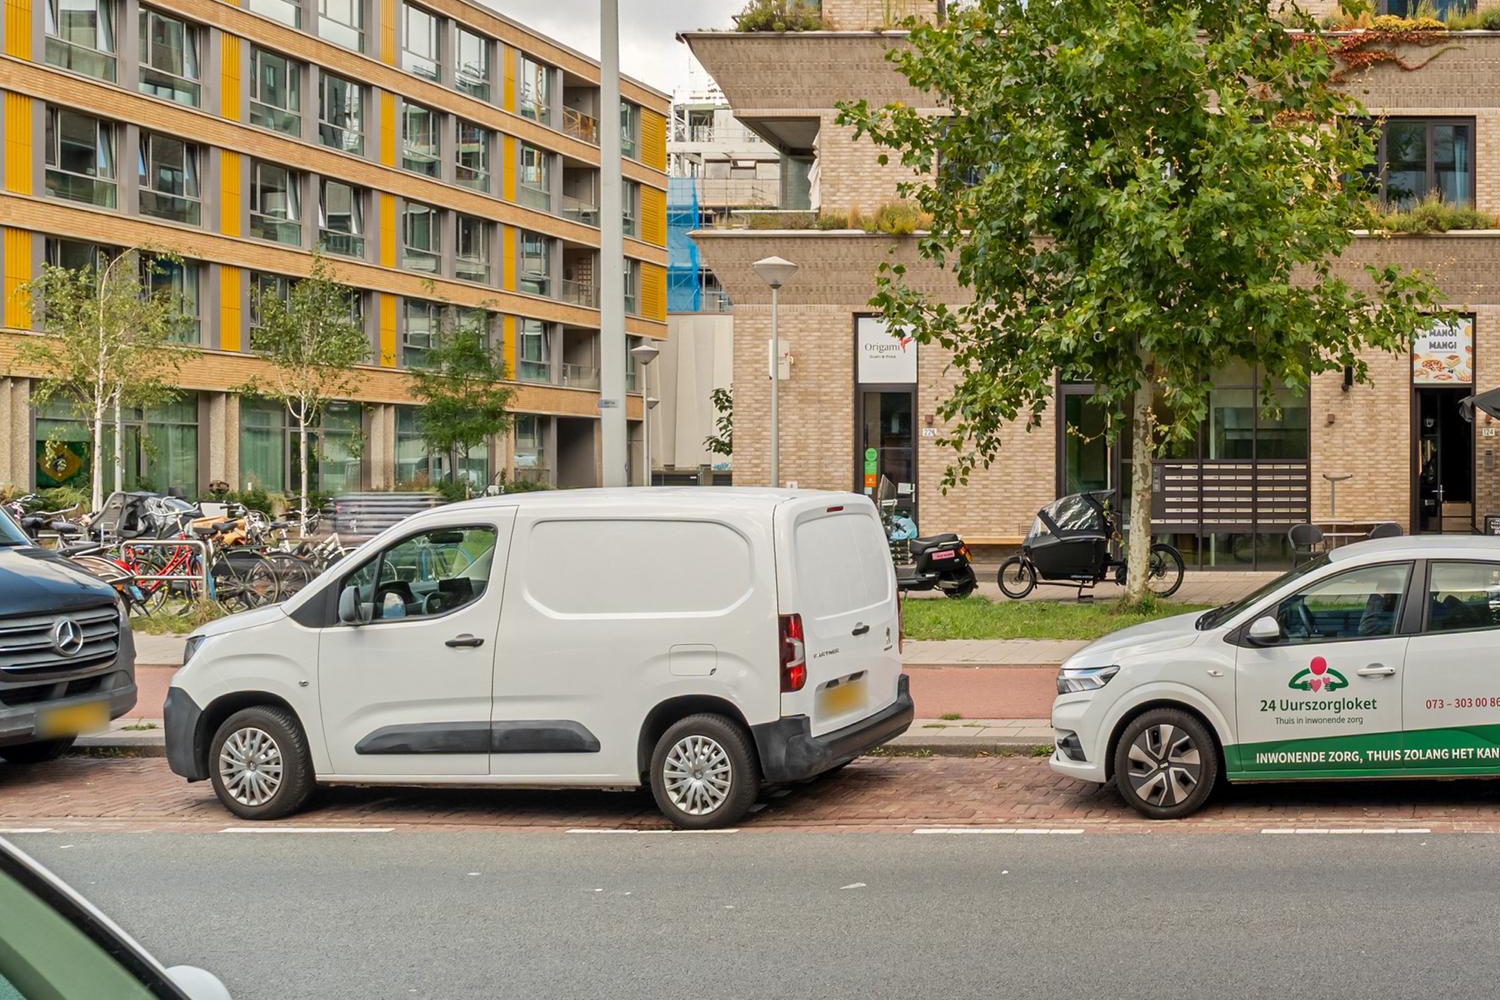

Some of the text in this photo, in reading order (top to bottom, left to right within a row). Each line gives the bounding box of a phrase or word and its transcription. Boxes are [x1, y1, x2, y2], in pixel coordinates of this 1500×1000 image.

[864, 342, 901, 354] Origami
[1429, 341, 1457, 350] MANGI
[1260, 697, 1377, 713] 24 Uurszorgloket
[1425, 699, 1444, 710] 073
[1455, 698, 1473, 708] 303
[1475, 697, 1488, 708] 00
[1275, 716, 1295, 725] Thuis
[1305, 716, 1345, 724] inwonende
[1347, 716, 1364, 725] zorg
[1256, 751, 1326, 764] INWONENDE
[1328, 751, 1363, 764] ZORG,
[1367, 749, 1401, 761] THUIS
[1404, 748, 1449, 761] ZOLANG
[1452, 748, 1474, 759] HET
